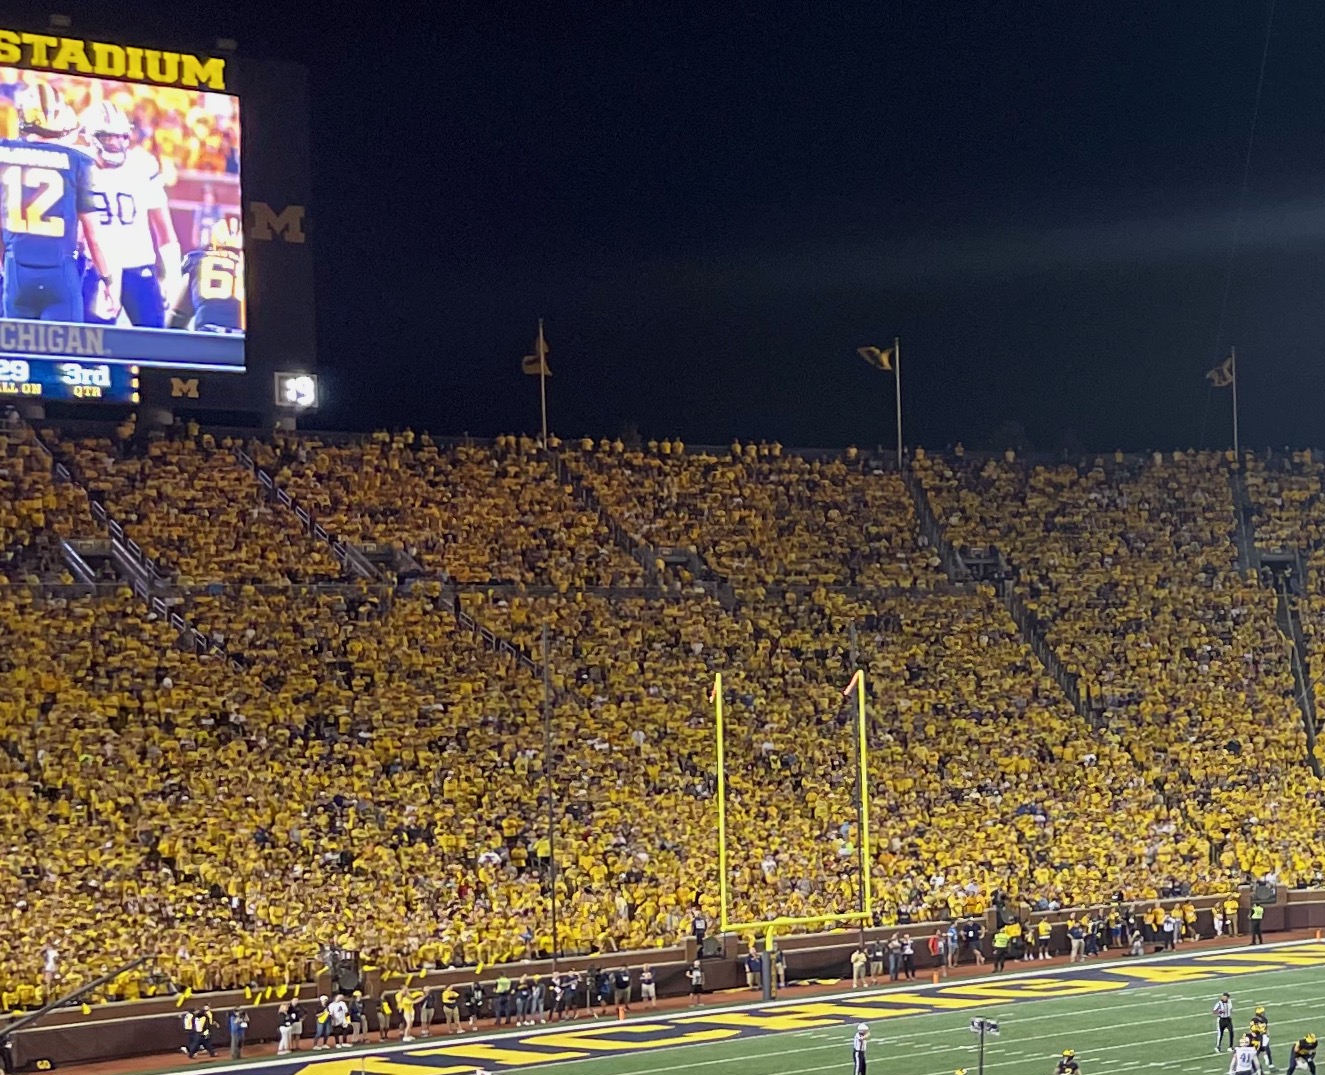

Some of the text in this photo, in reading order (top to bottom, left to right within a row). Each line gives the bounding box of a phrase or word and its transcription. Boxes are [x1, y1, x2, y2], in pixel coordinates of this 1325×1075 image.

[0, 29, 226, 90] STADIUM
[252, 201, 305, 243] M
[60, 362, 110, 387] 3rd
[73, 385, 102, 398] QTR
[170, 377, 200, 398] M
